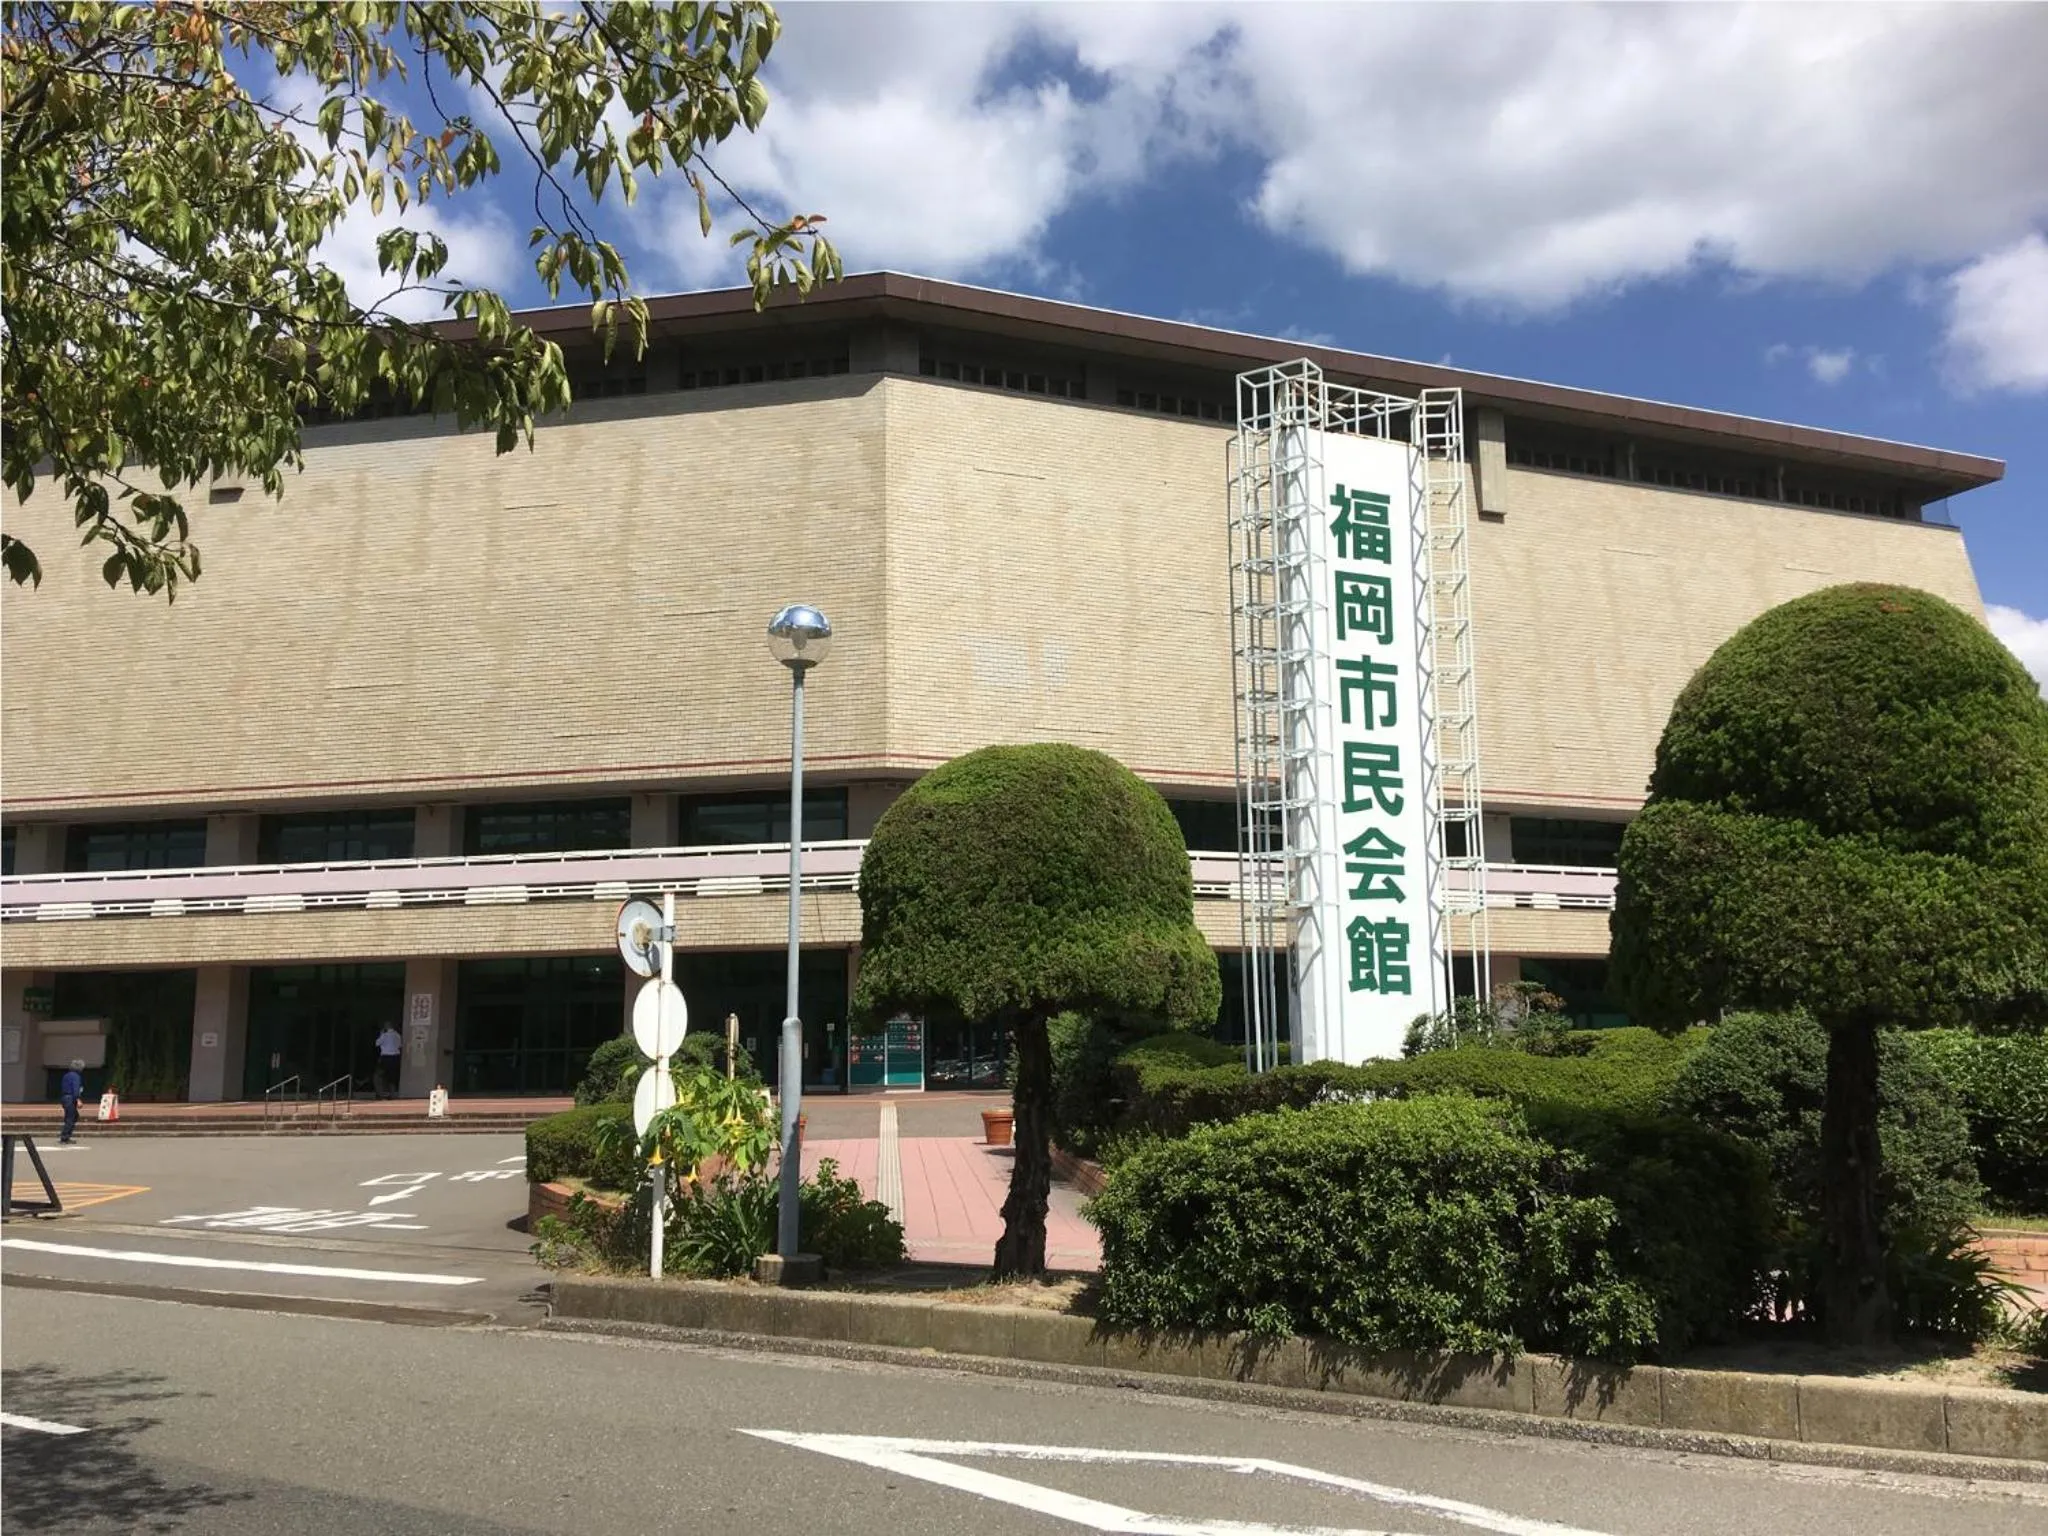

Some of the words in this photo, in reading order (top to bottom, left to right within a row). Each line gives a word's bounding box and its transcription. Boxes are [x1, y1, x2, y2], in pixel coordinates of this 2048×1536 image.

[1330, 484, 1412, 996] 福岡市民会館
